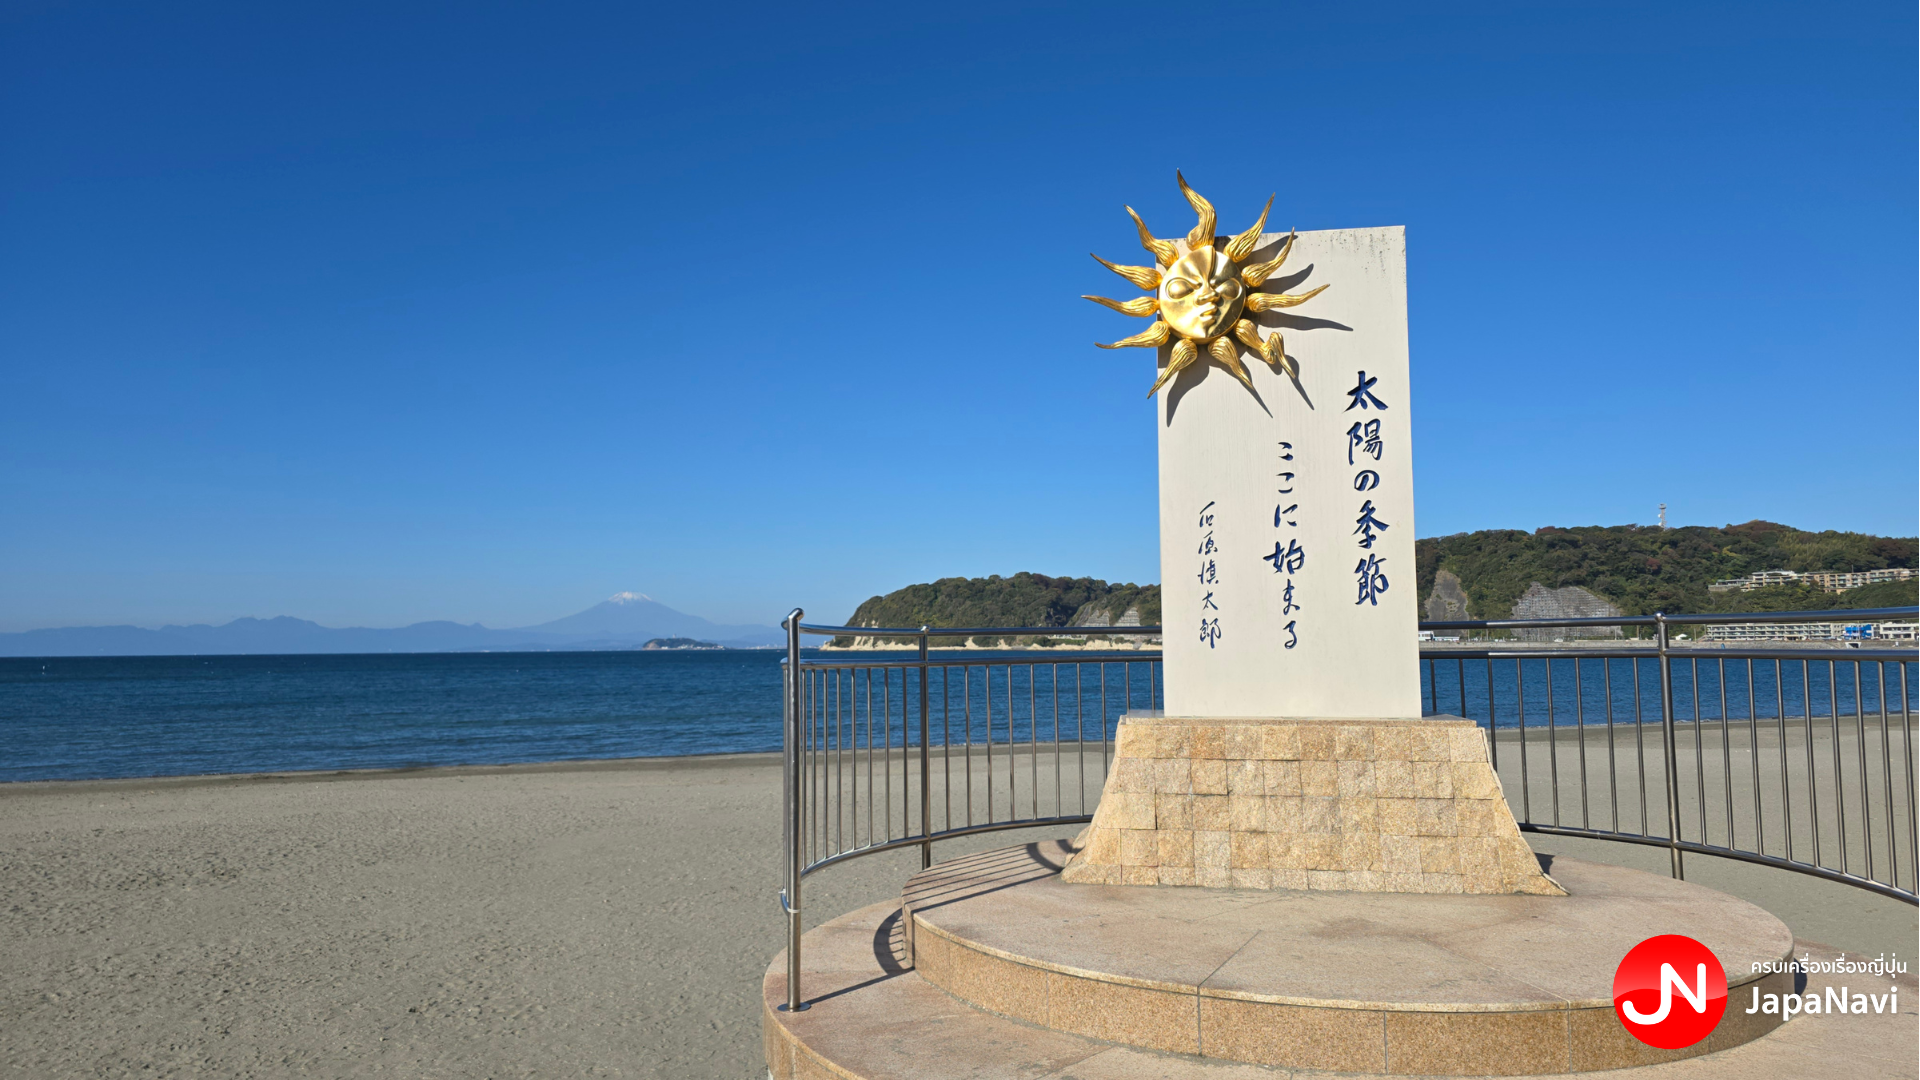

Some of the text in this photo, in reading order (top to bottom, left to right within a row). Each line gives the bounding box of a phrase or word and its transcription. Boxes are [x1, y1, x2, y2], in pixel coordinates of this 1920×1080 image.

[1262, 441, 1305, 649] ここに始まる
[1343, 370, 1390, 606] 太陽の季節
